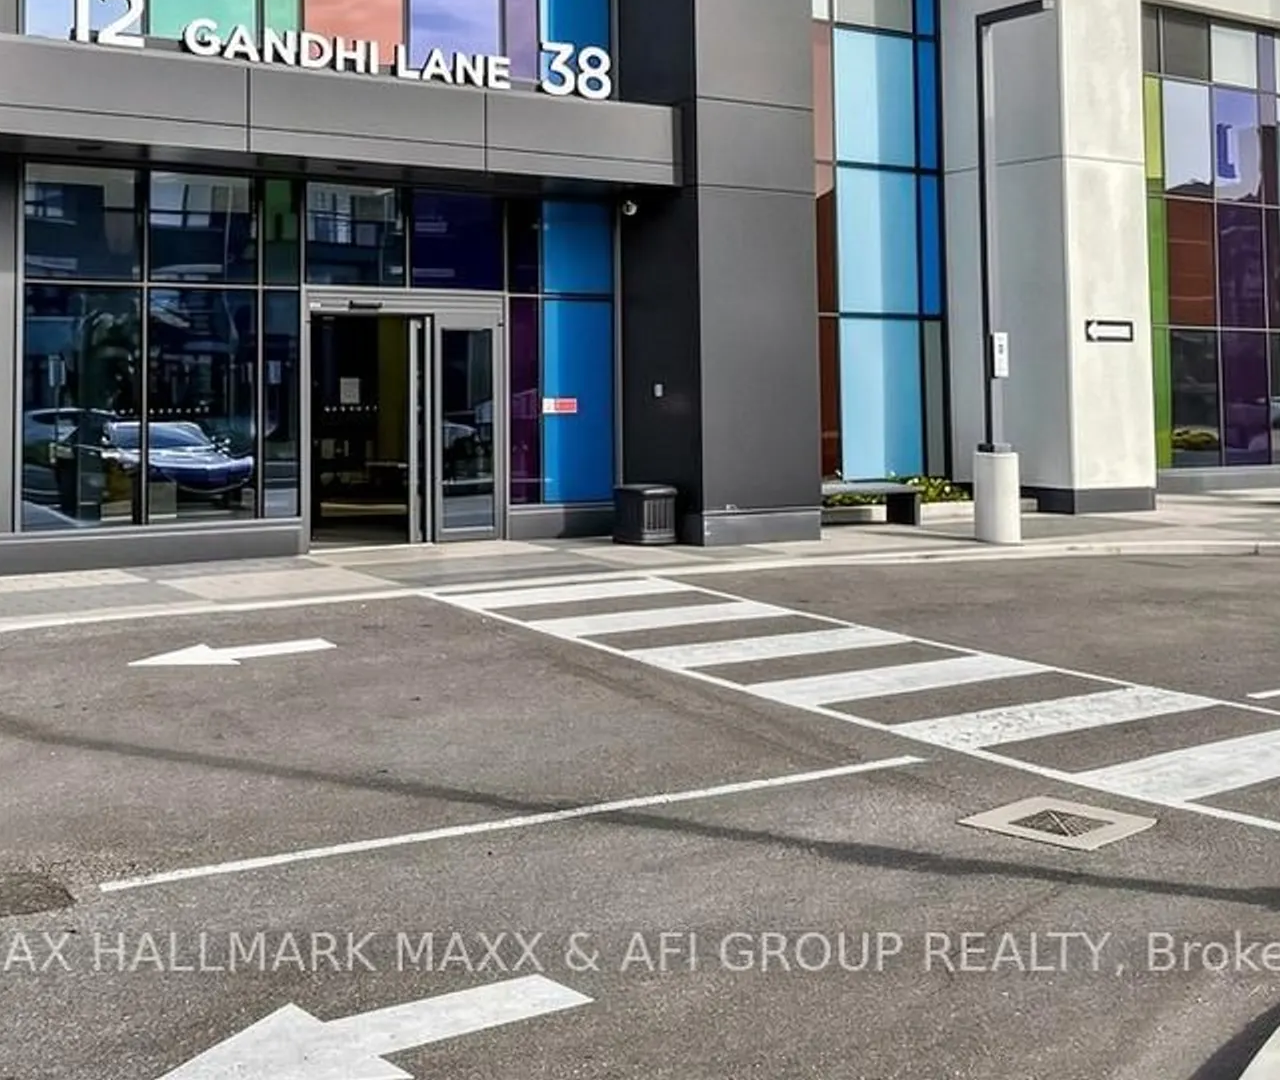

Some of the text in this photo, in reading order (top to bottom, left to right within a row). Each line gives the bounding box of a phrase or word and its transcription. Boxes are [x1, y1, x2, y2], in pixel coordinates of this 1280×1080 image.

[183, 18, 380, 75] GANDHI
[396, 44, 511, 90] LANE
[540, 42, 612, 99] 38
